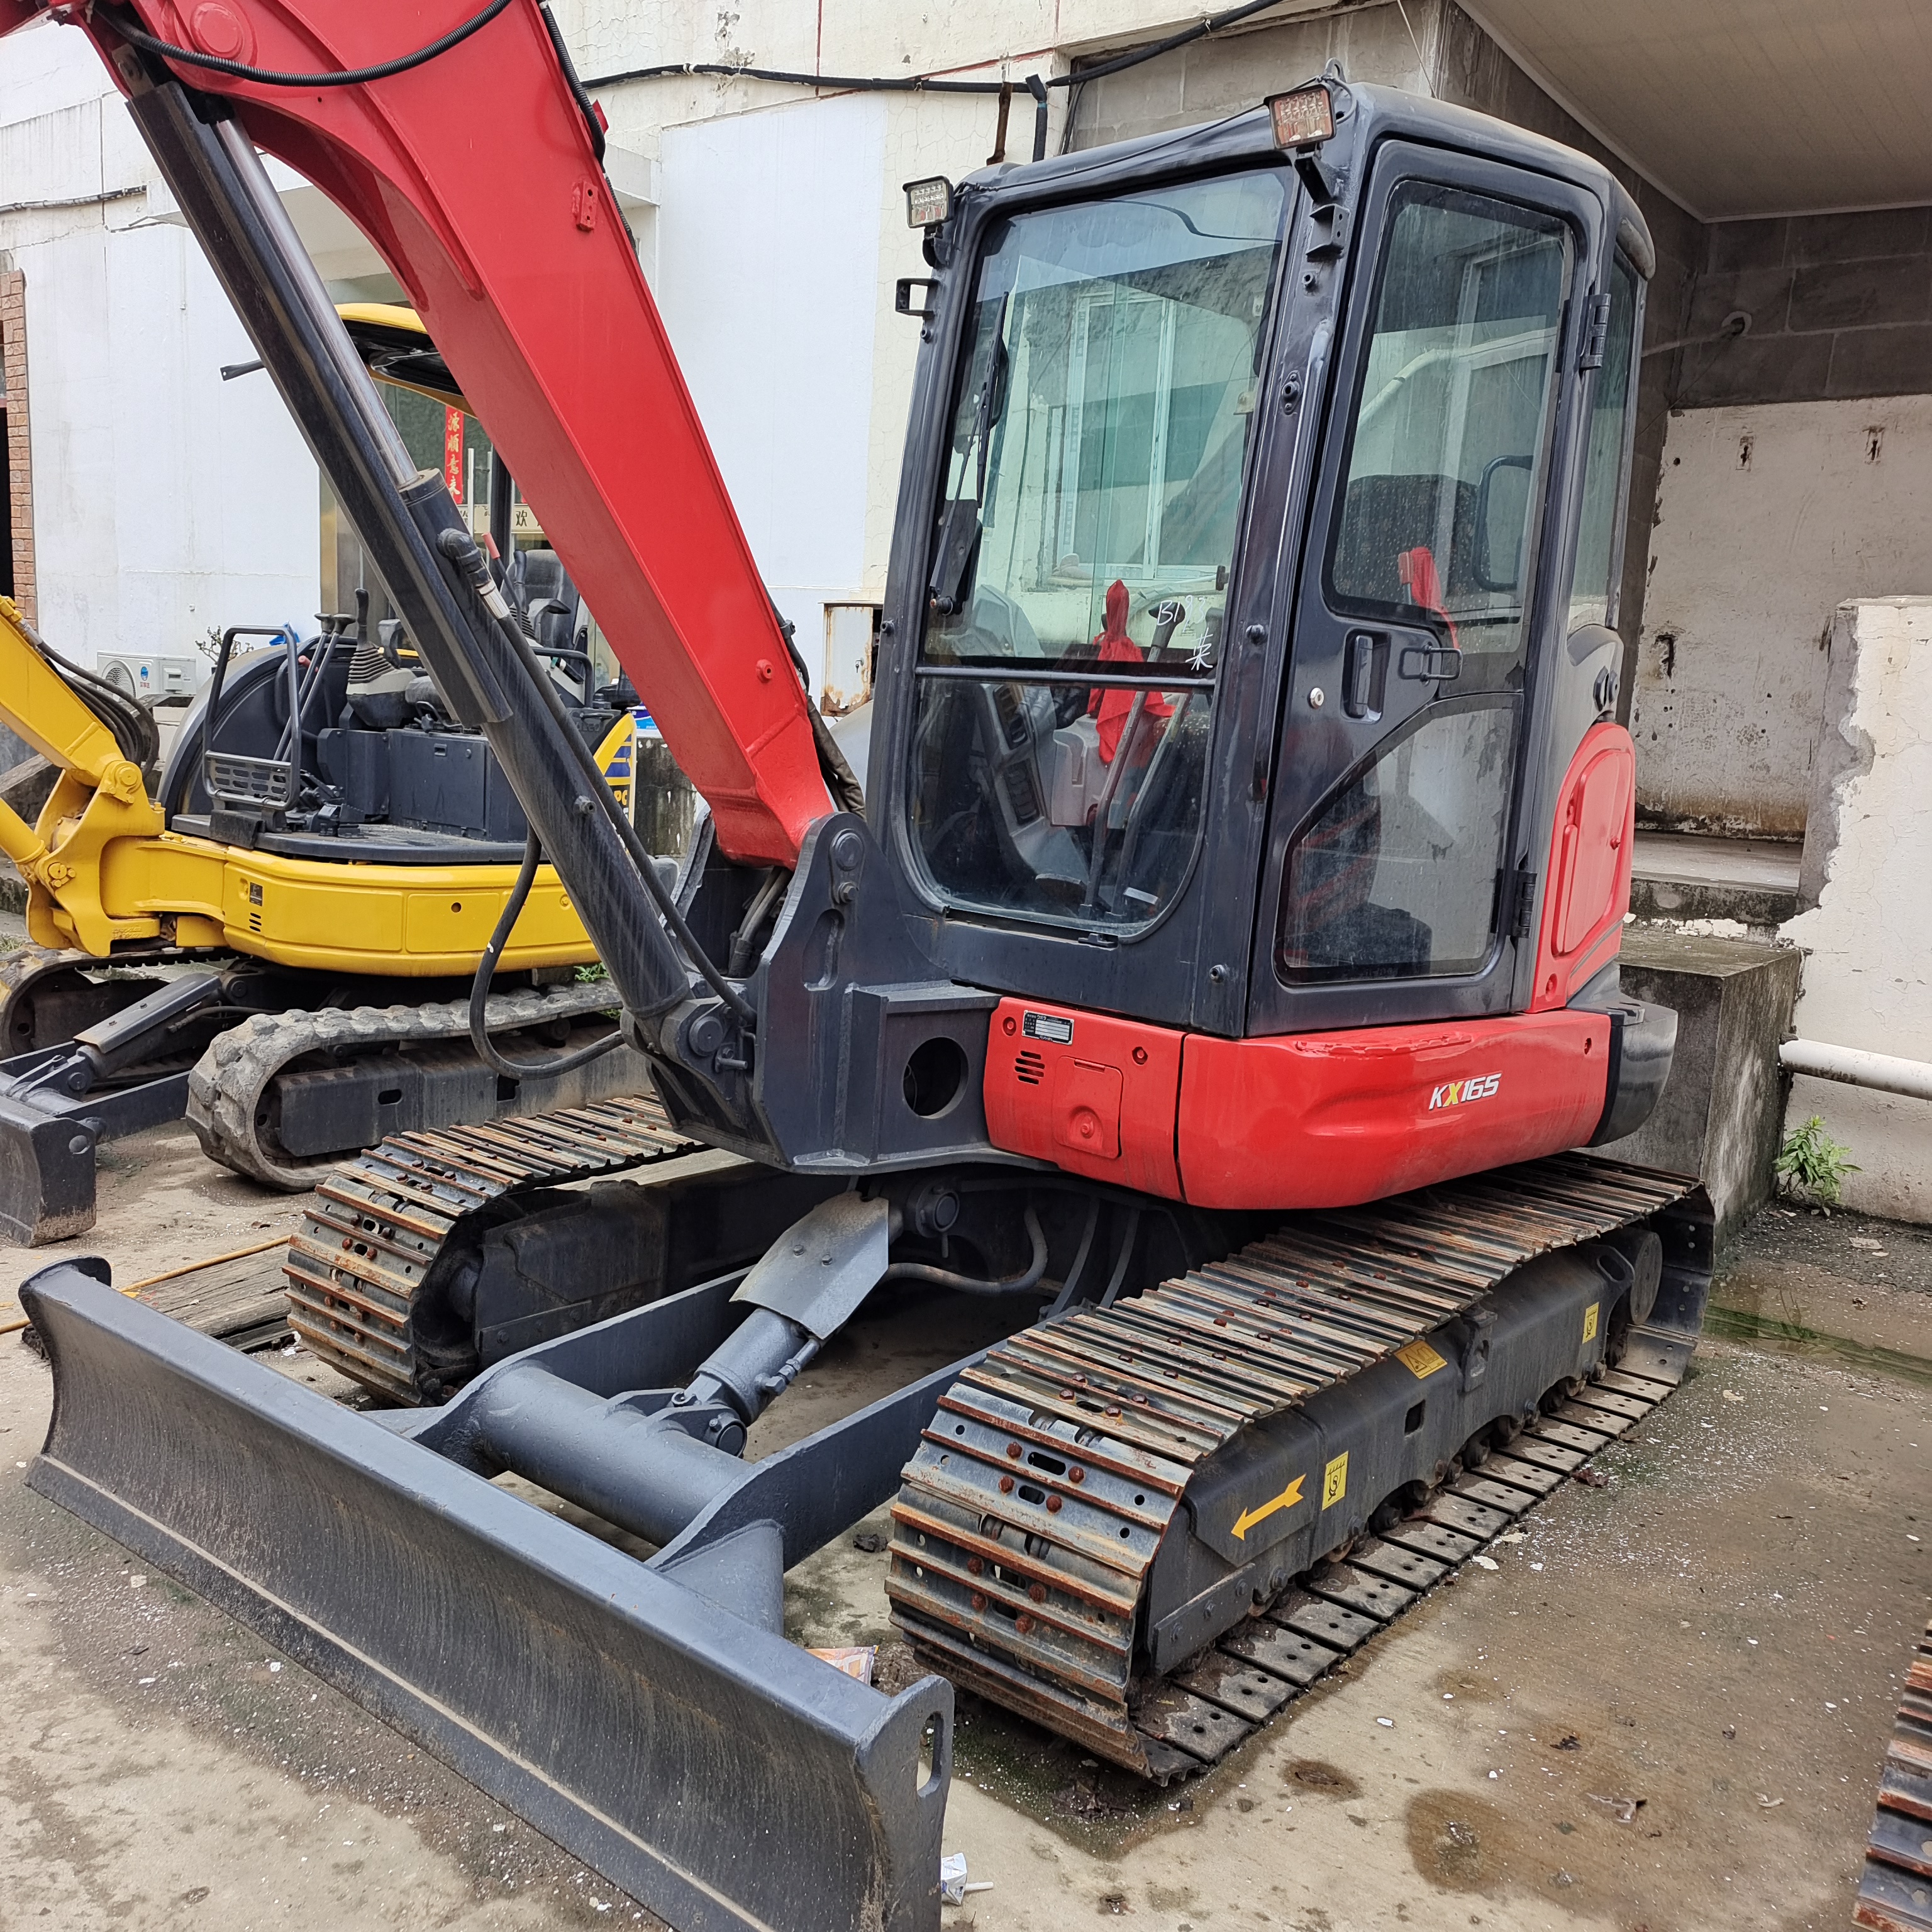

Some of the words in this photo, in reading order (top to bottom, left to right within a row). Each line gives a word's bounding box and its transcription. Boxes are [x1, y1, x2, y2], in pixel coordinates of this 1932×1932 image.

[1157, 594, 1206, 633] B193
[614, 790, 628, 806] PC
[1428, 1073, 1502, 1111] KX165
